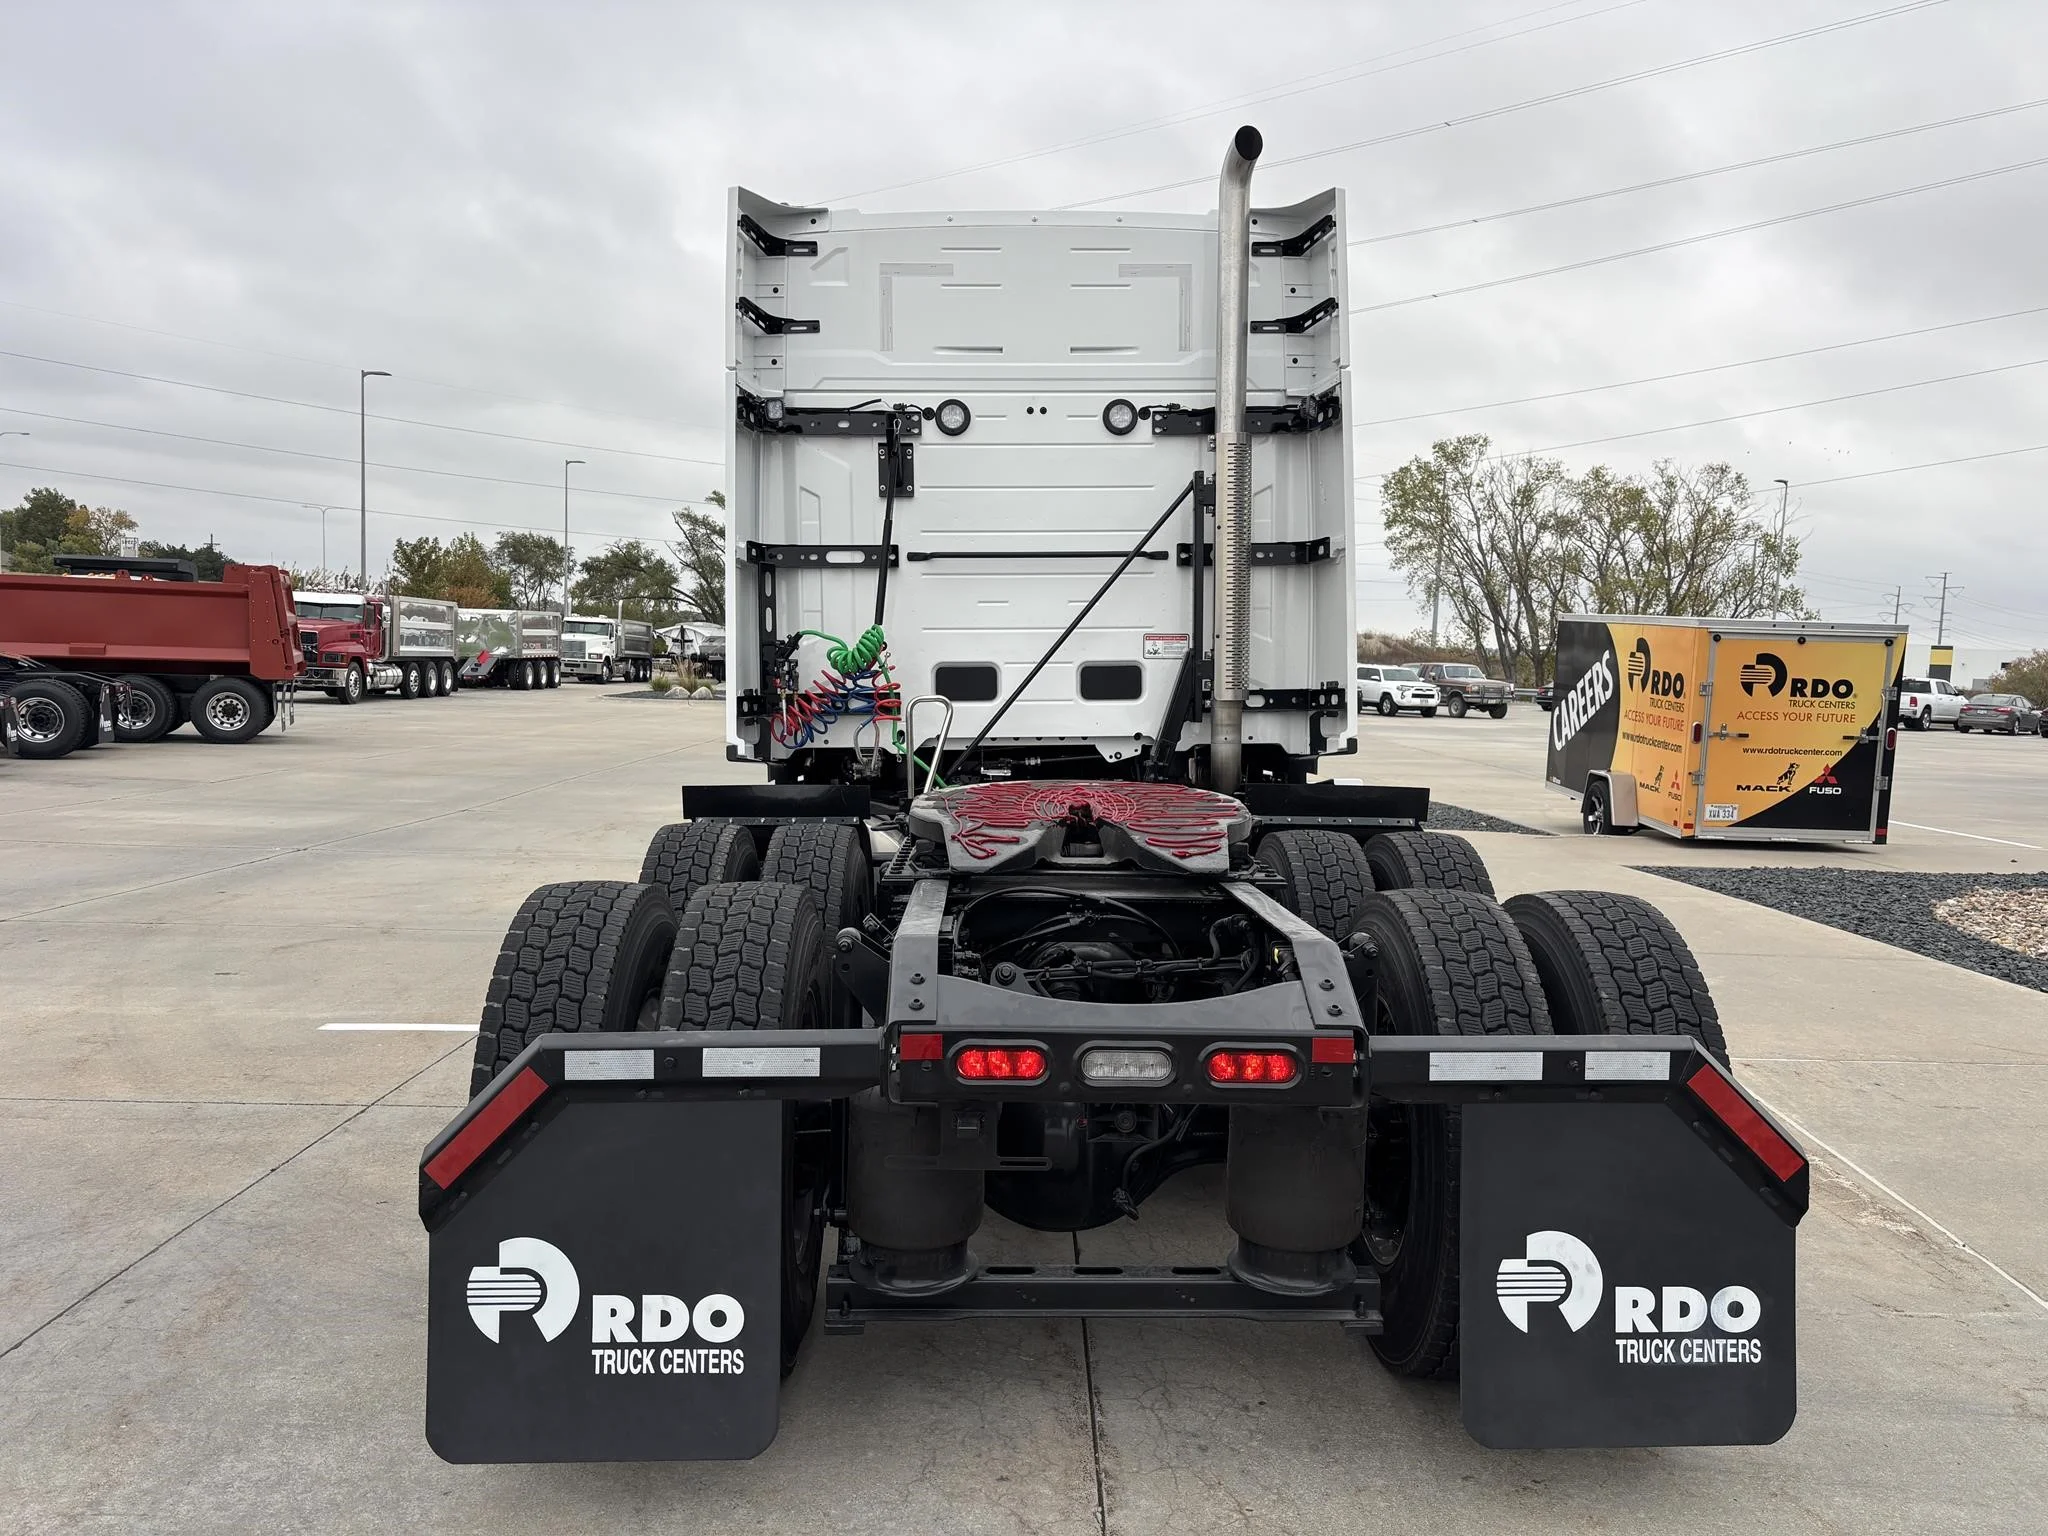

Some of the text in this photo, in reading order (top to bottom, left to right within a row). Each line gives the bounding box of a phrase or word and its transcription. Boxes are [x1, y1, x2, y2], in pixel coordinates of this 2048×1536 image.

[1651, 670, 1685, 699] RDO
[1790, 678, 1854, 699] RDO
[1553, 650, 1613, 751] CAREERS
[1649, 698, 1685, 713] TRUCK CENTERS
[1788, 700, 1856, 709] TRUCK CENTERS
[1624, 709, 1685, 732] ACCESS YOUR FUTURE
[1736, 711, 1856, 723] ACCESS YOUR FUTURE
[1742, 747, 1843, 756] www.rdotruckcenter.com
[1639, 782, 1660, 793] MACK
[1736, 784, 1791, 793] MACK
[1809, 786, 1842, 795] FUSO
[592, 1294, 745, 1344] RDO
[1615, 1285, 1761, 1333] RDO
[591, 1348, 745, 1375] TRUCK CENTERS
[1615, 1338, 1762, 1364] TRUCK CENTERS
